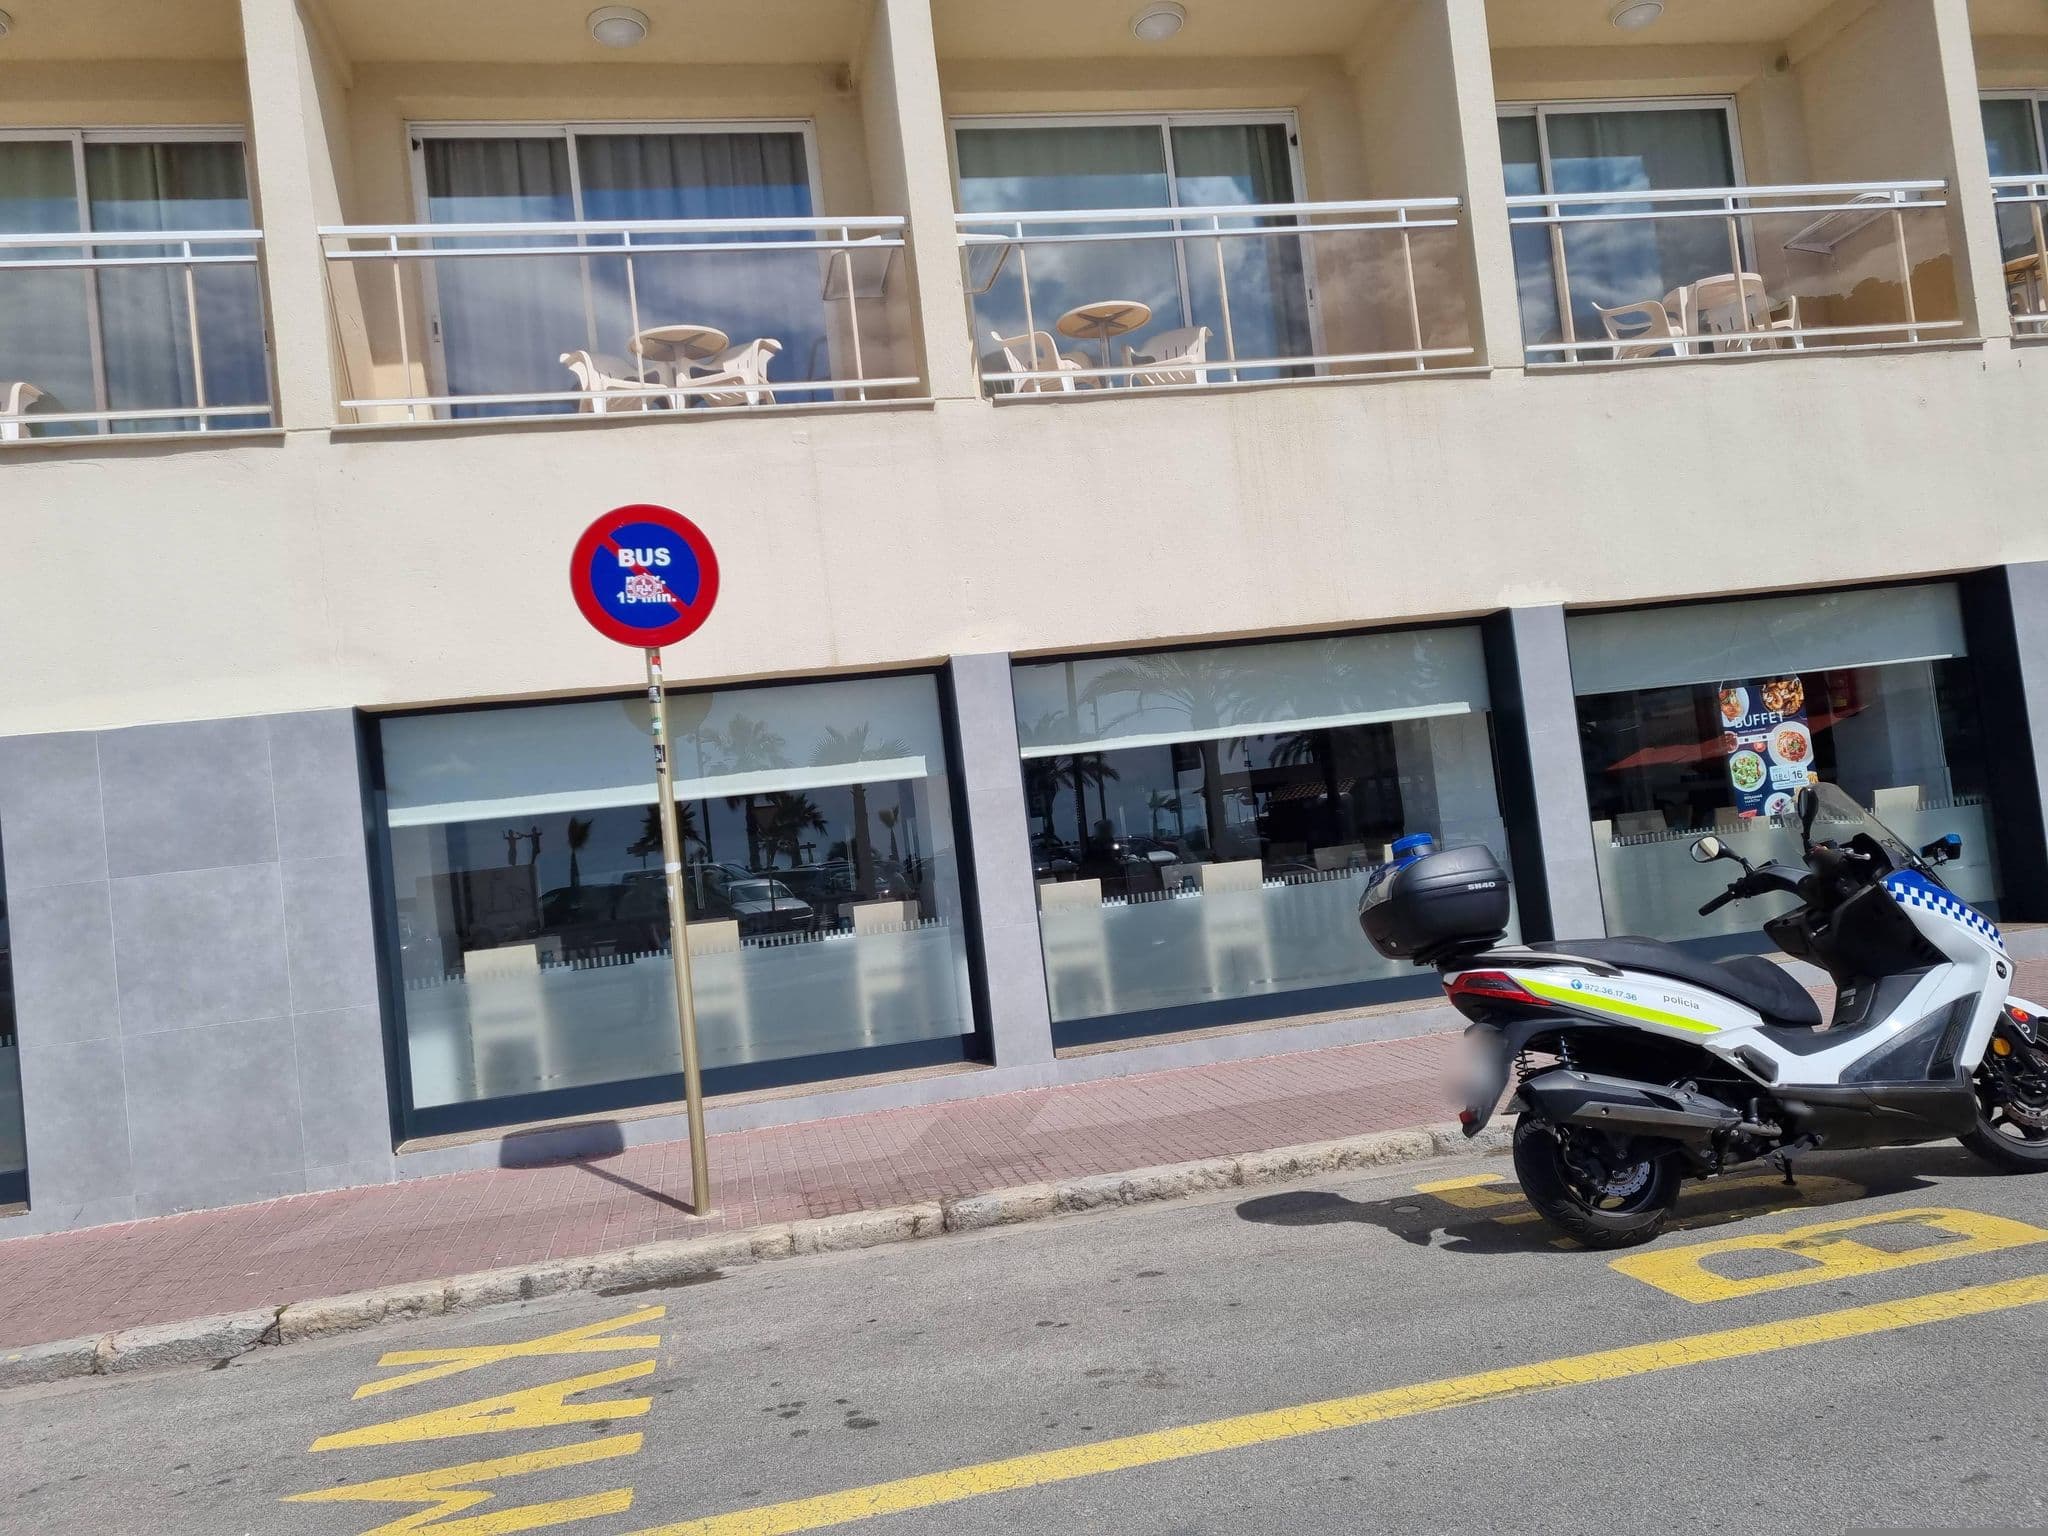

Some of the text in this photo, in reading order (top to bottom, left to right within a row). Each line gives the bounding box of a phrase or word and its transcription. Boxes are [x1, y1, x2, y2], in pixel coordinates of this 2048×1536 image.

[618, 547, 671, 567] BUS
[1735, 710, 1784, 729] BUFFET
[1663, 994, 1700, 1010] policia
